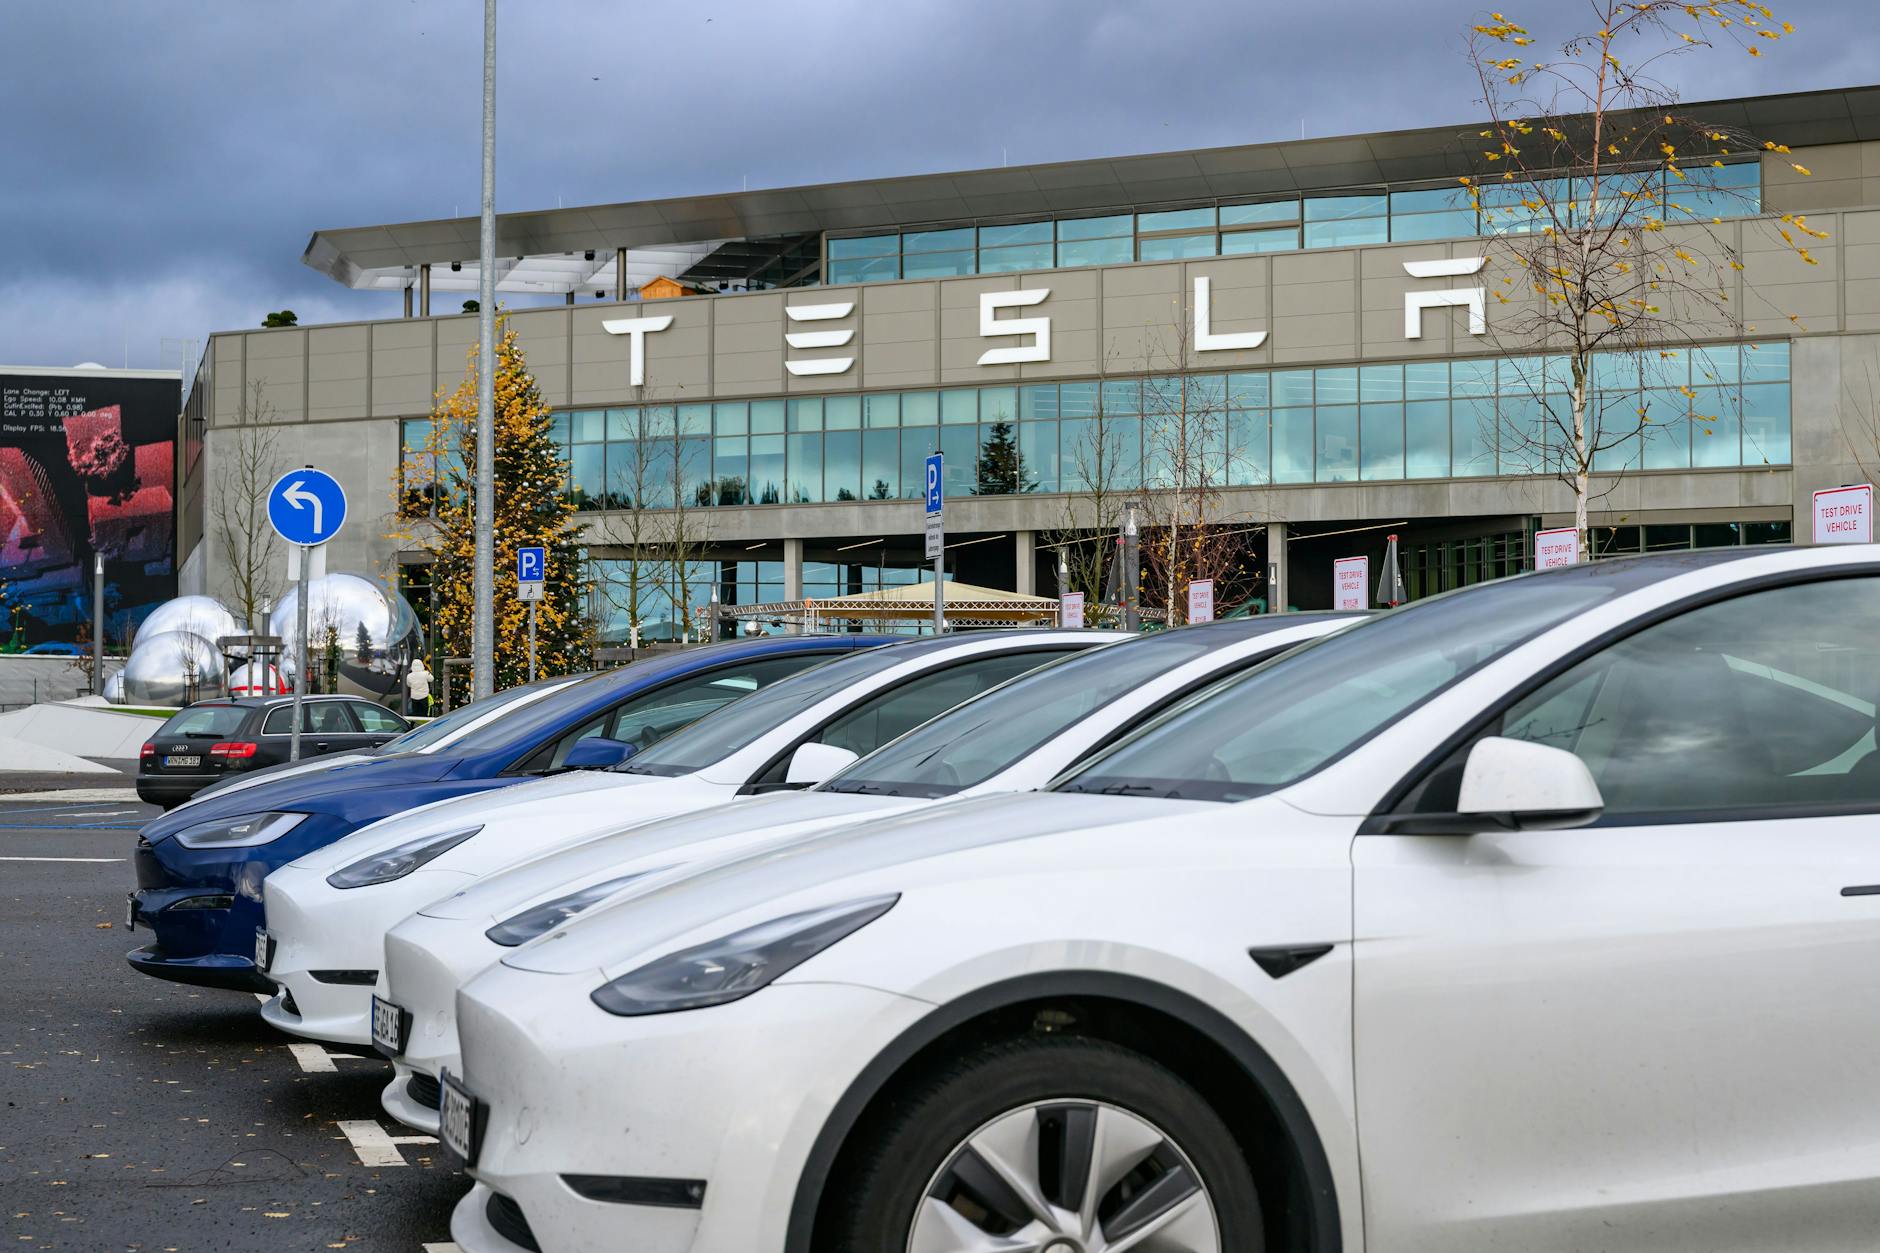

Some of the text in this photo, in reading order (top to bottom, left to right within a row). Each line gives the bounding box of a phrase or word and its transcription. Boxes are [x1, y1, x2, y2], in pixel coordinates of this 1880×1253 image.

[602, 257, 1486, 387] TESLA
[23, 388, 50, 397] Change:
[3, 424, 27, 432] Display
[30, 424, 45, 432] FPS:
[928, 464, 938, 506] P
[1821, 503, 1862, 519] TEST DRIVE
[1826, 519, 1857, 533] VEHICLE
[1541, 543, 1572, 555] TEST DRIVE
[522, 552, 537, 578] P
[1545, 557, 1568, 567] VEHICLE
[1338, 570, 1363, 580] TEST DRIVE
[1342, 581, 1360, 591] VEHICLE
